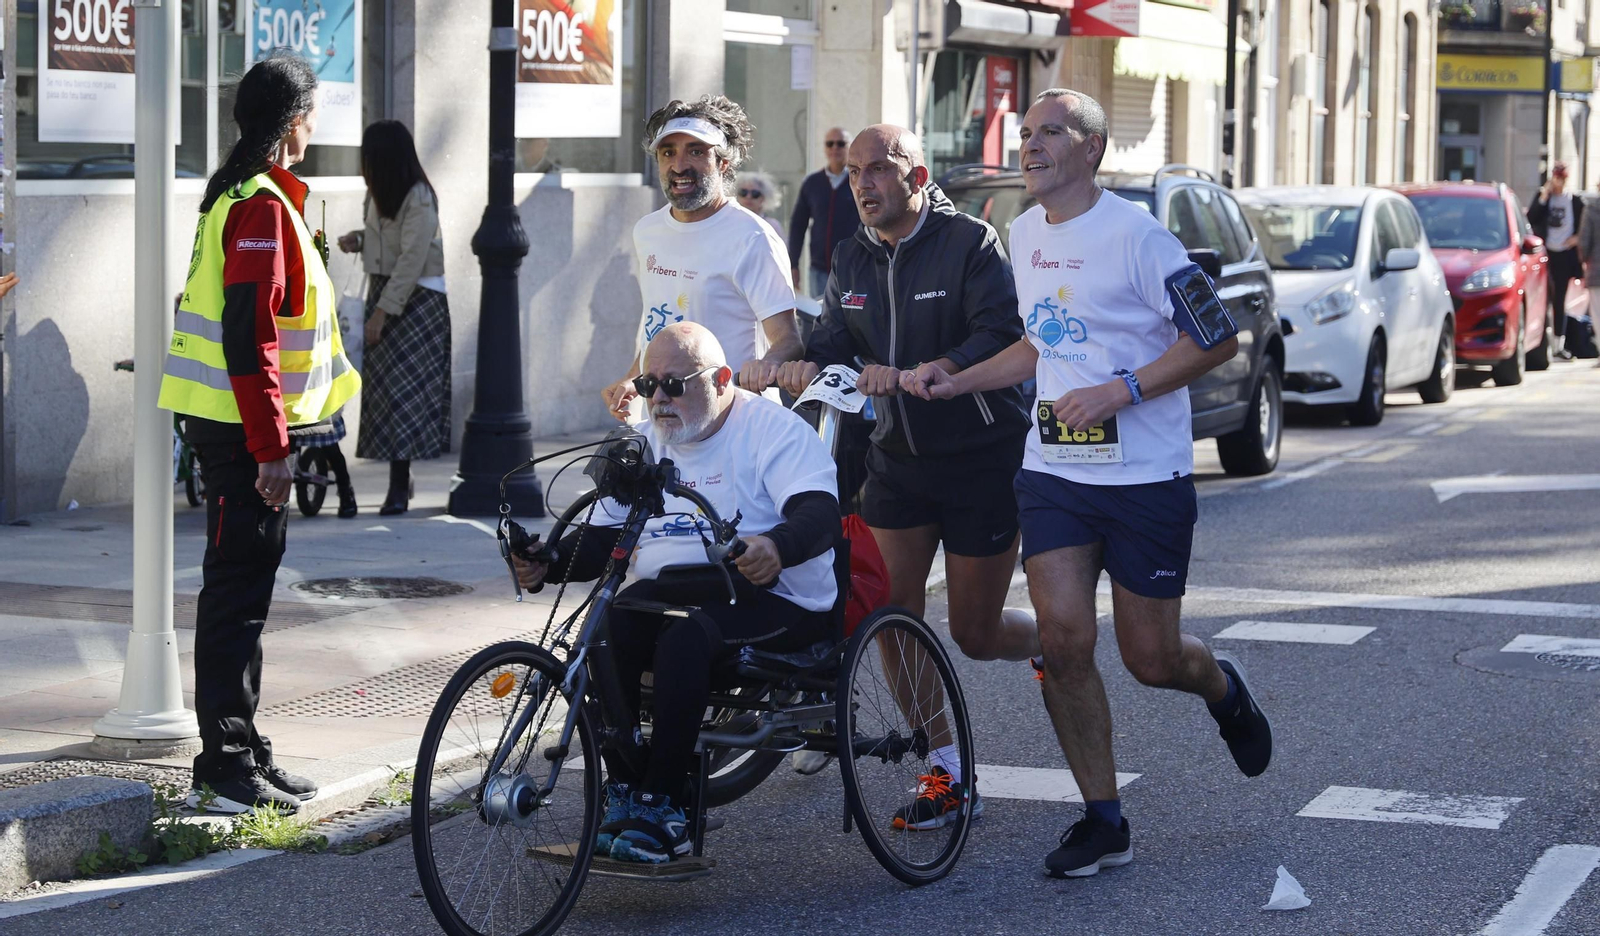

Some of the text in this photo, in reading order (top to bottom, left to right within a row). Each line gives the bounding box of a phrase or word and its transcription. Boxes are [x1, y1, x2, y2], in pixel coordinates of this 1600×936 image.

[321, 89, 355, 108] ¿Subes?
[1038, 259, 1060, 270] ribera
[652, 265, 677, 277] ribera
